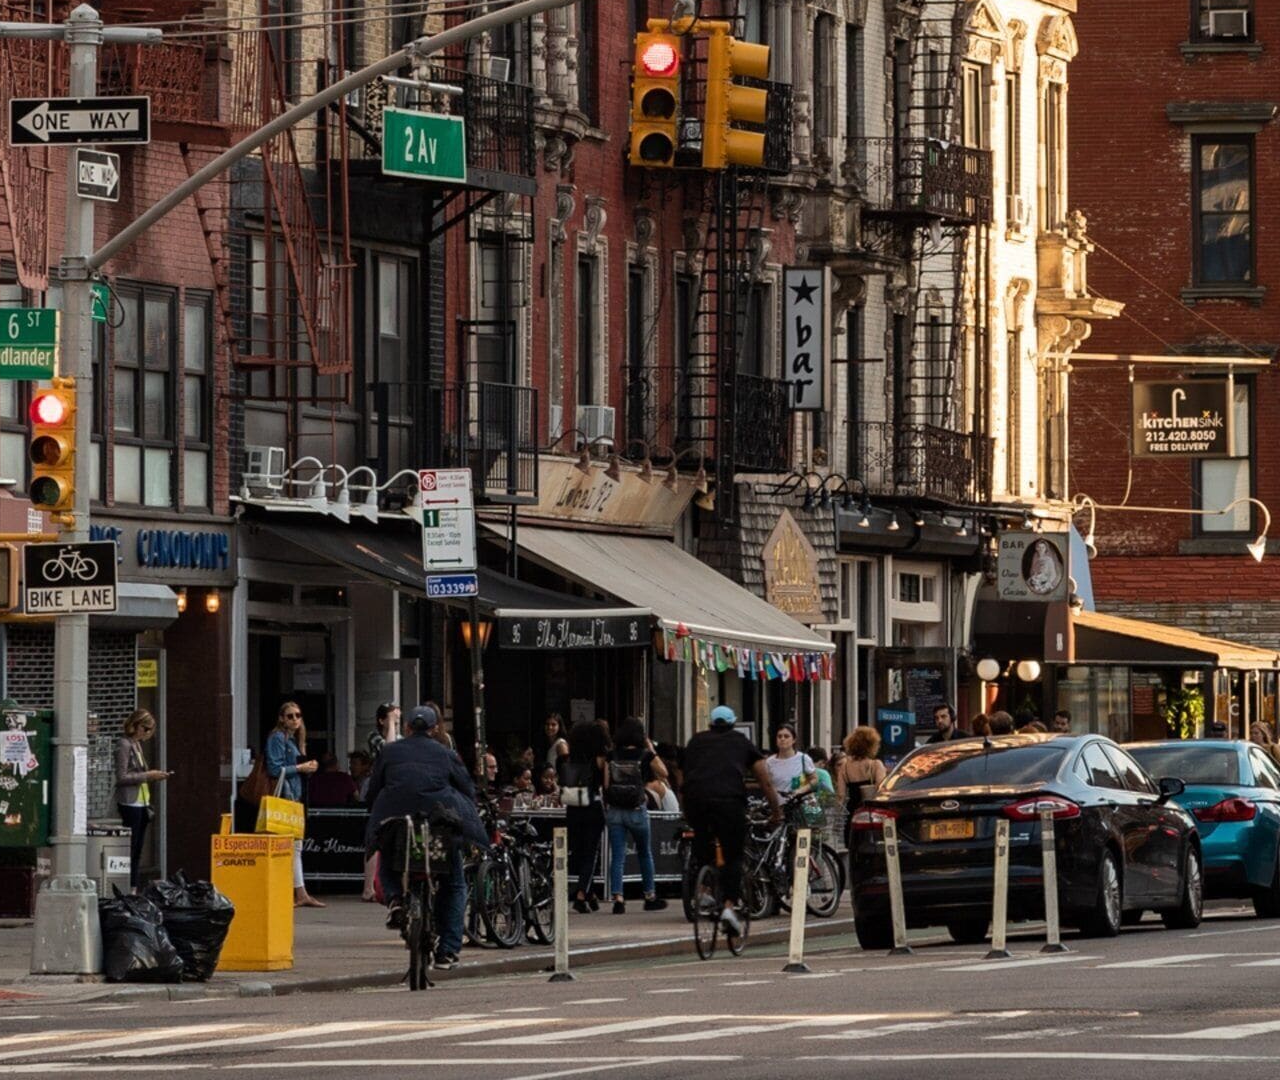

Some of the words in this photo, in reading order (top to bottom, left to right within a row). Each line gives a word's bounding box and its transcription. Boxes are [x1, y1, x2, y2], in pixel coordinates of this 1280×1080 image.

[32, 113, 70, 130] ONE
[90, 112, 131, 129] WAY
[405, 126, 414, 162] 2
[418, 128, 437, 165] Av
[81, 164, 95, 182] ONE
[102, 167, 115, 184] WAY
[8, 313, 19, 339] 6
[27, 311, 42, 327] ST
[793, 315, 813, 404] bar
[1145, 431, 1216, 442] 212.420.8050
[1150, 443, 1169, 452] FREE
[1170, 442, 1210, 451] DELIVERY
[593, 481, 613, 512] 92
[428, 511, 435, 527] 1
[1002, 541, 1024, 549] BAR
[30, 591, 63, 608] BIKE
[72, 588, 112, 606] LANE
[429, 583, 465, 594] 103339
[536, 619, 557, 648] The
